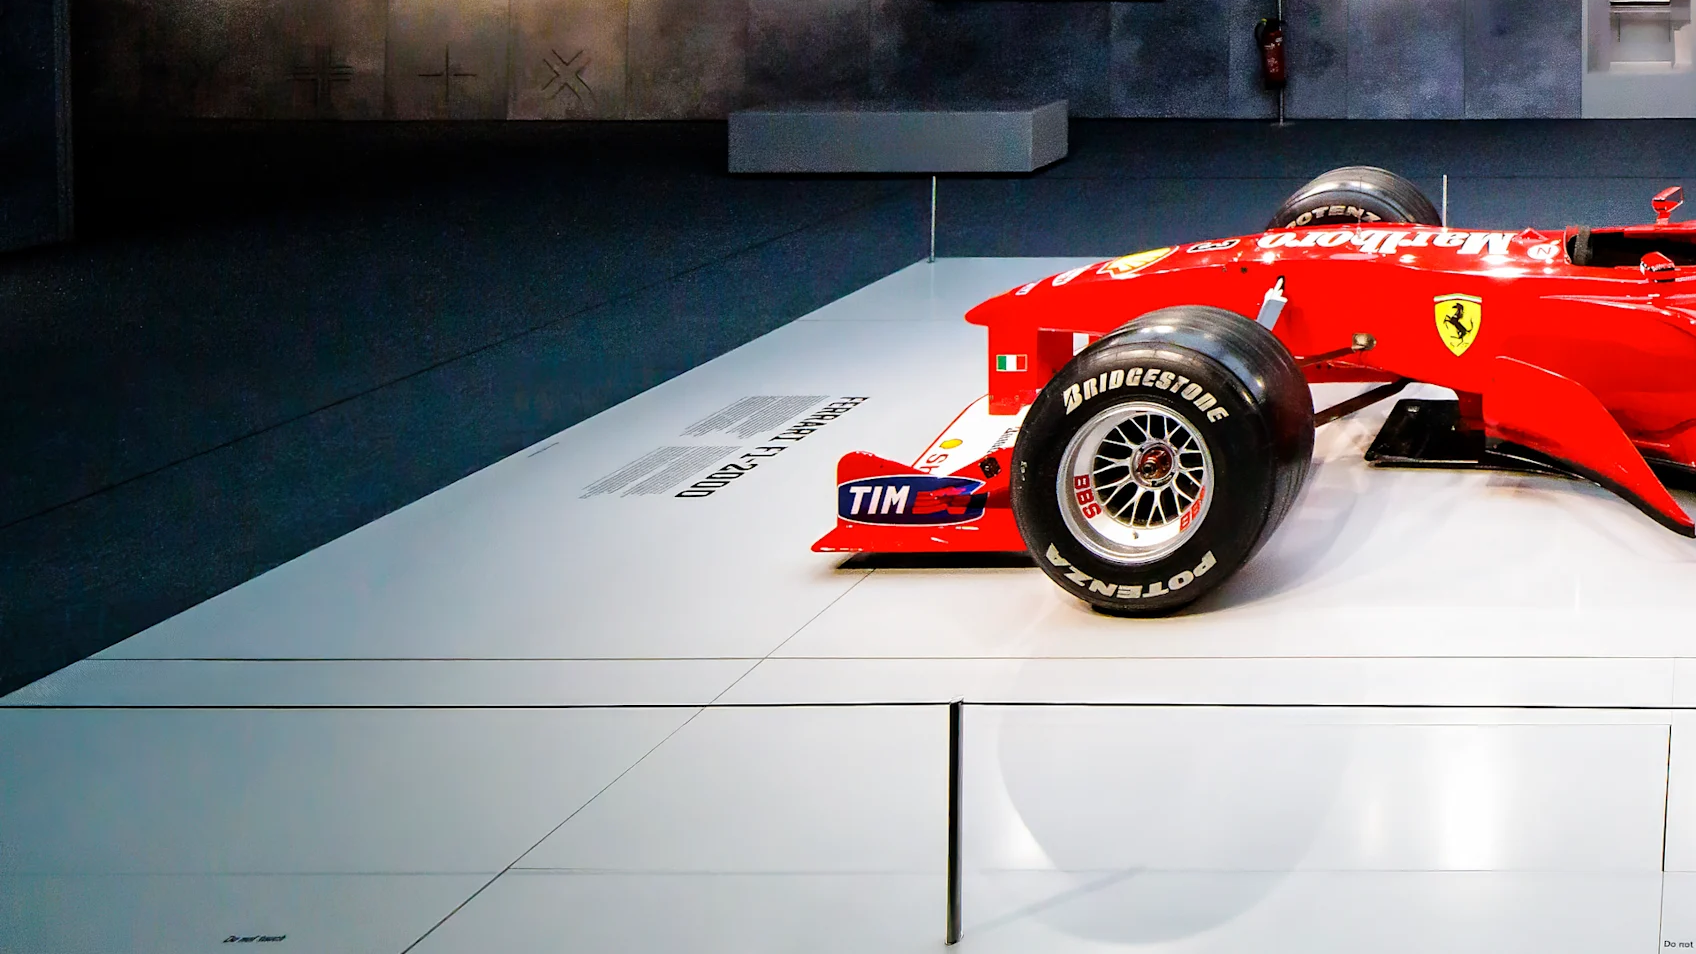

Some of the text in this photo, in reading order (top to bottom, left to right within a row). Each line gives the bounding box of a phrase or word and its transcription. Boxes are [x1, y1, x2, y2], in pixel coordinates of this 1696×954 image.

[1257, 230, 1517, 256] Marlboro
[1062, 367, 1230, 423] BRIDGESTONE
[769, 396, 871, 442] FERRARI
[674, 446, 789, 498] F1-2000
[849, 485, 911, 515] TIM
[1073, 474, 1103, 520] BBS
[1045, 542, 1218, 600] POTENZA
[1664, 940, 1676, 948] Do
